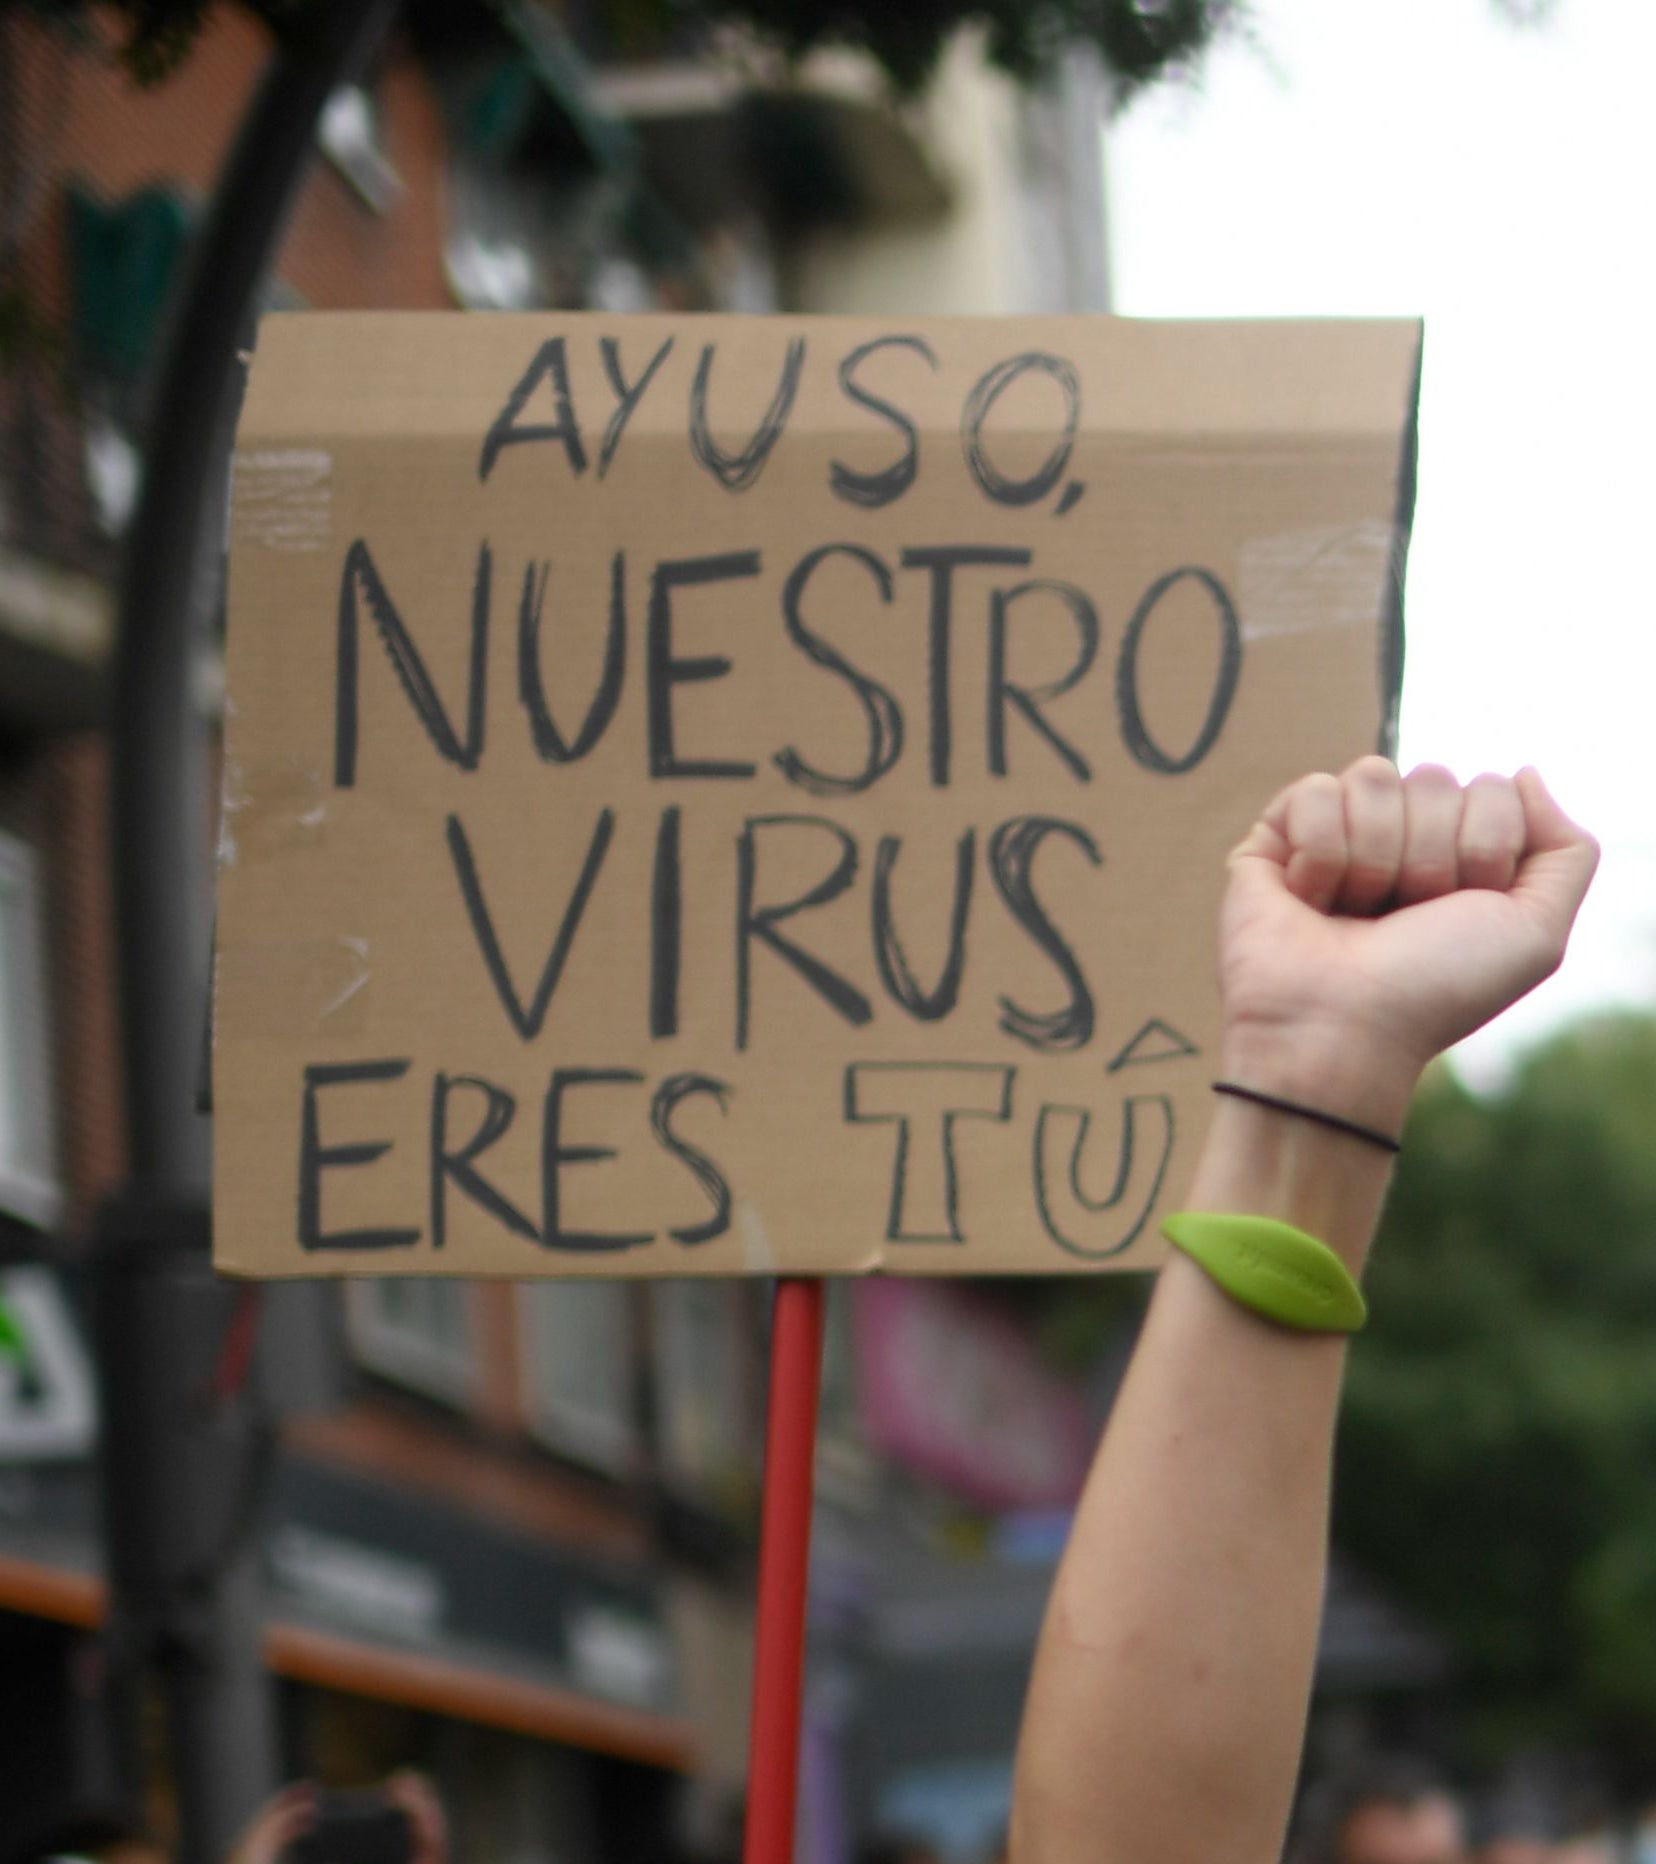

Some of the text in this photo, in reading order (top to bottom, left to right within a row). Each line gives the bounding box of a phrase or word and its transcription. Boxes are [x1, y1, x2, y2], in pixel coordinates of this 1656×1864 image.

[478, 335, 1088, 516] AYUSO,
[335, 539, 1243, 794] NUESTRO
[447, 807, 1103, 1053] VIRUS
[297, 1060, 732, 1254] ERES
